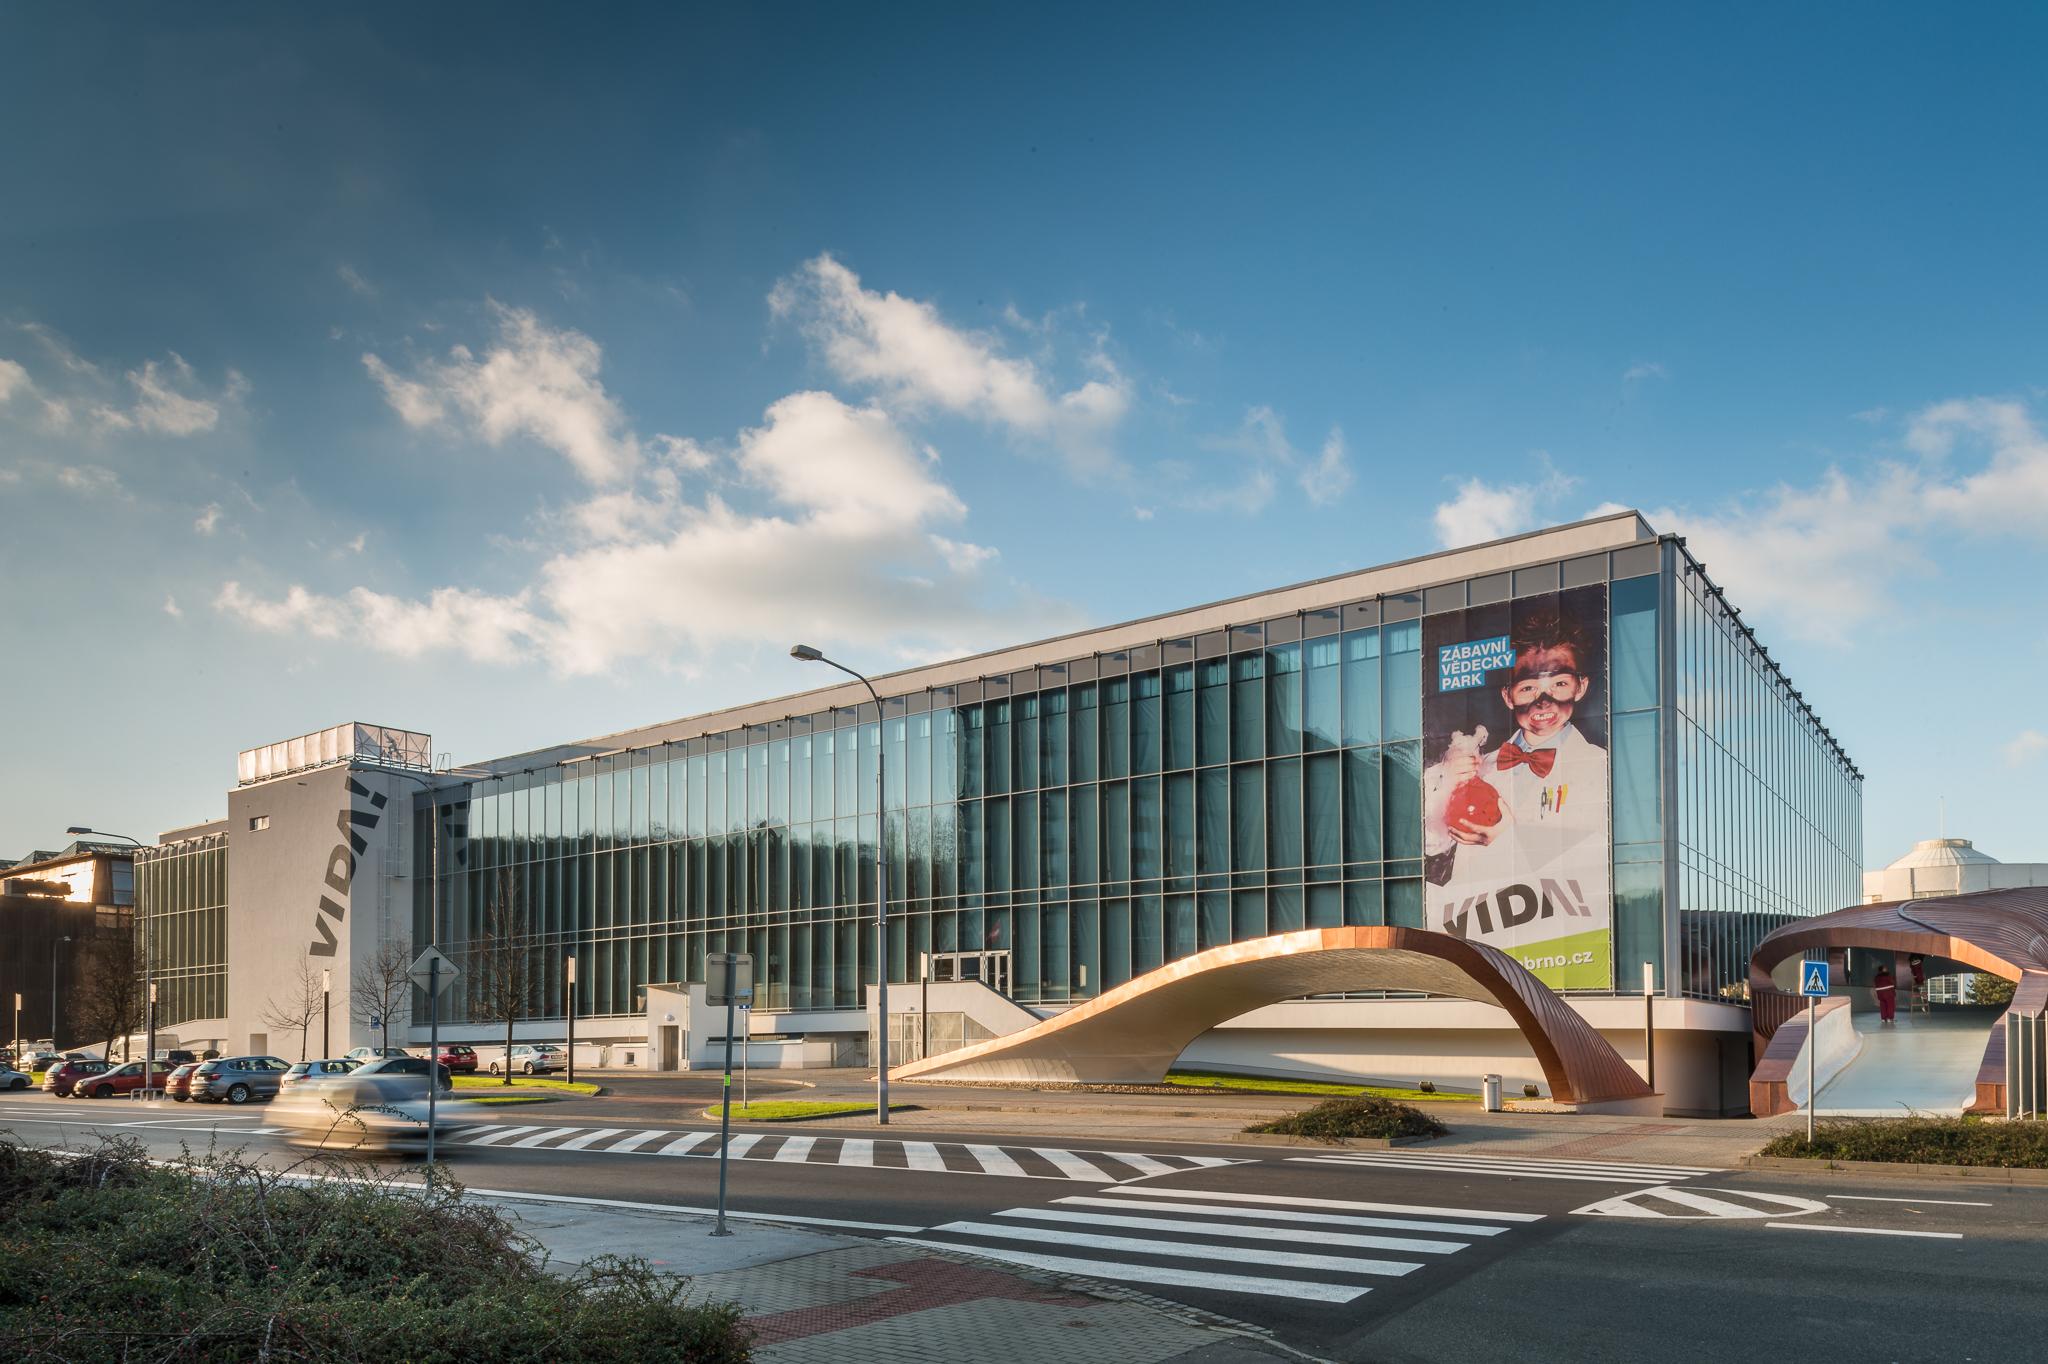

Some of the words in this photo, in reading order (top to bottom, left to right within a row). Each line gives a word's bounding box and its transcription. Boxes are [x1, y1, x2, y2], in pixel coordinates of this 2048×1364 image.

[1441, 637, 1507, 662] ZÁBAVNÍ
[1441, 651, 1513, 676] VĚDECKÝ
[1442, 672, 1482, 690] PARK
[309, 775, 389, 957] VIDA!
[1443, 878, 1592, 940] VIDA!
[1517, 951, 1594, 971] brno.cz
